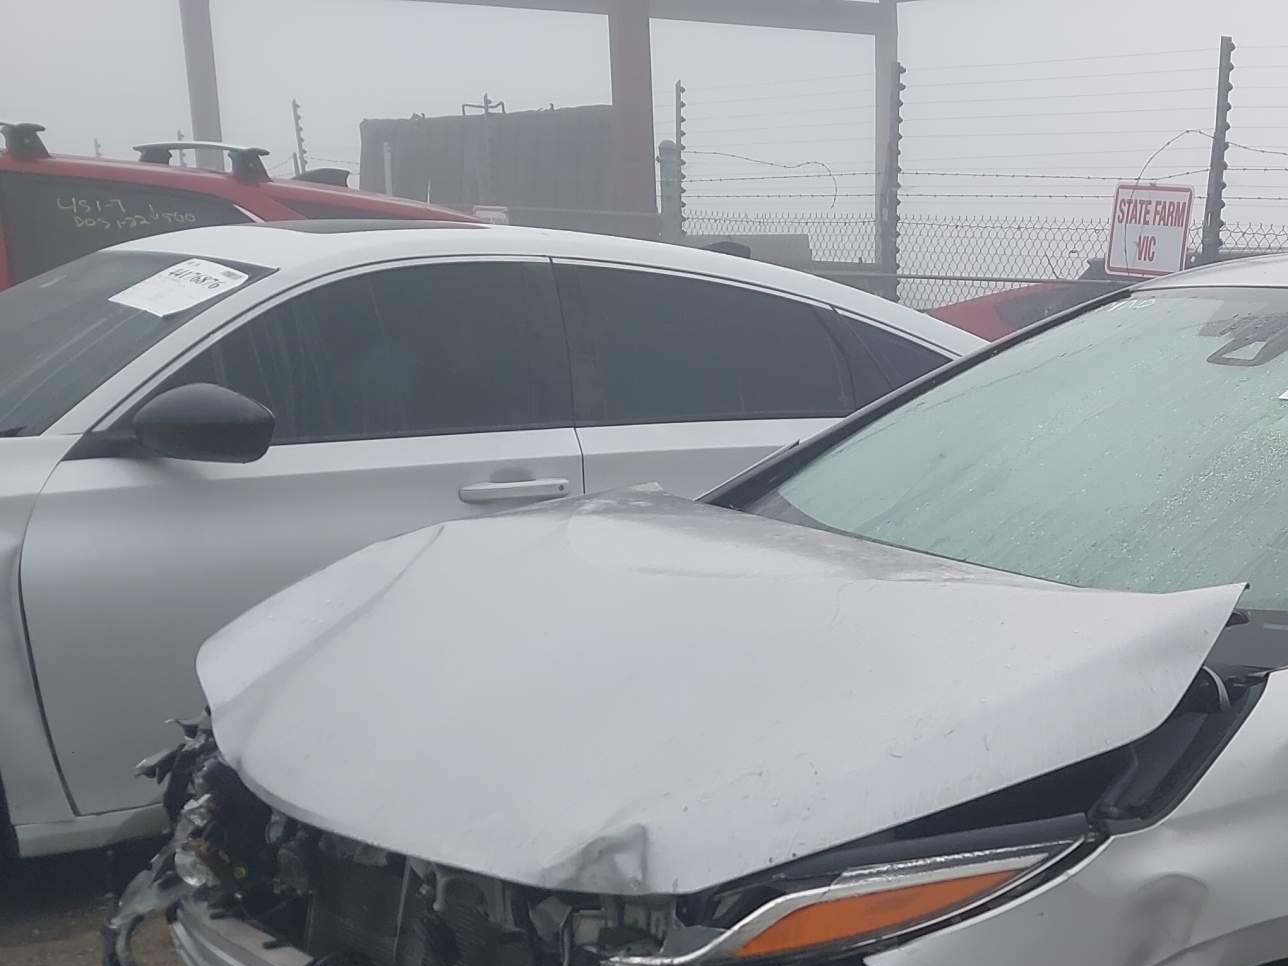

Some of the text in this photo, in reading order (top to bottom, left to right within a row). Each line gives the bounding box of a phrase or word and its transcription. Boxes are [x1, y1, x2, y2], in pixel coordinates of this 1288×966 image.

[1117, 198, 1187, 227] STATE FARM
[1137, 235, 1156, 261] VIC
